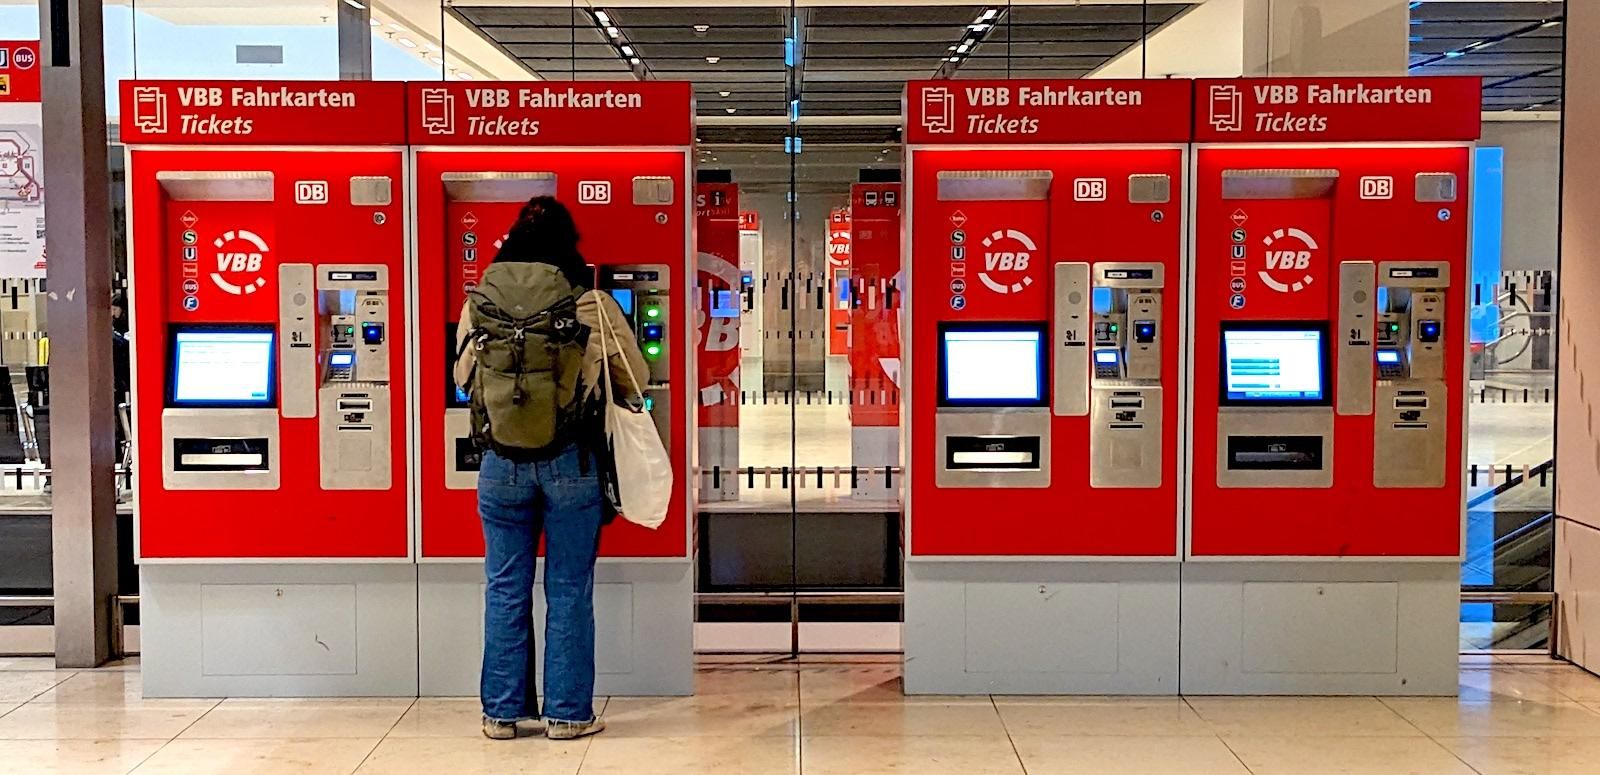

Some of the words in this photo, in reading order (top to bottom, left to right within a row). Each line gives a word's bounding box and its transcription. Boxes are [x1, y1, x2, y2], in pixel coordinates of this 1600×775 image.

[16, 54, 33, 63] BUS
[178, 87, 223, 107] VBB
[231, 86, 356, 108] Fahrkarten
[466, 88, 510, 108] VBB
[518, 87, 642, 109] Fahrkarten
[965, 87, 1010, 107] VBB
[1018, 86, 1142, 107] Fahrkarten
[1253, 85, 1299, 105] VBB
[1307, 83, 1432, 104] Fahrkarten
[180, 114, 253, 135] Tickets
[467, 116, 540, 136] Tickets
[967, 114, 1040, 134] Tickets
[1255, 112, 1328, 132] Tickets
[299, 184, 325, 201] DB
[582, 183, 608, 201] DB
[1077, 181, 1103, 198] DB
[1364, 178, 1390, 197] DB
[185, 231, 195, 244] S
[465, 233, 475, 245] S
[953, 231, 964, 243] S
[1234, 229, 1244, 242] S
[185, 247, 195, 260] U
[465, 249, 475, 261] U
[953, 247, 963, 259] U
[1234, 246, 1244, 258] U
[1265, 250, 1312, 270] VBB
[216, 252, 263, 272] VBB
[985, 251, 1030, 271] VBB
[184, 283, 197, 291] BUS
[1232, 281, 1244, 289] BUS
[186, 297, 196, 309] F
[953, 296, 962, 308] F
[1232, 296, 1242, 308] F
